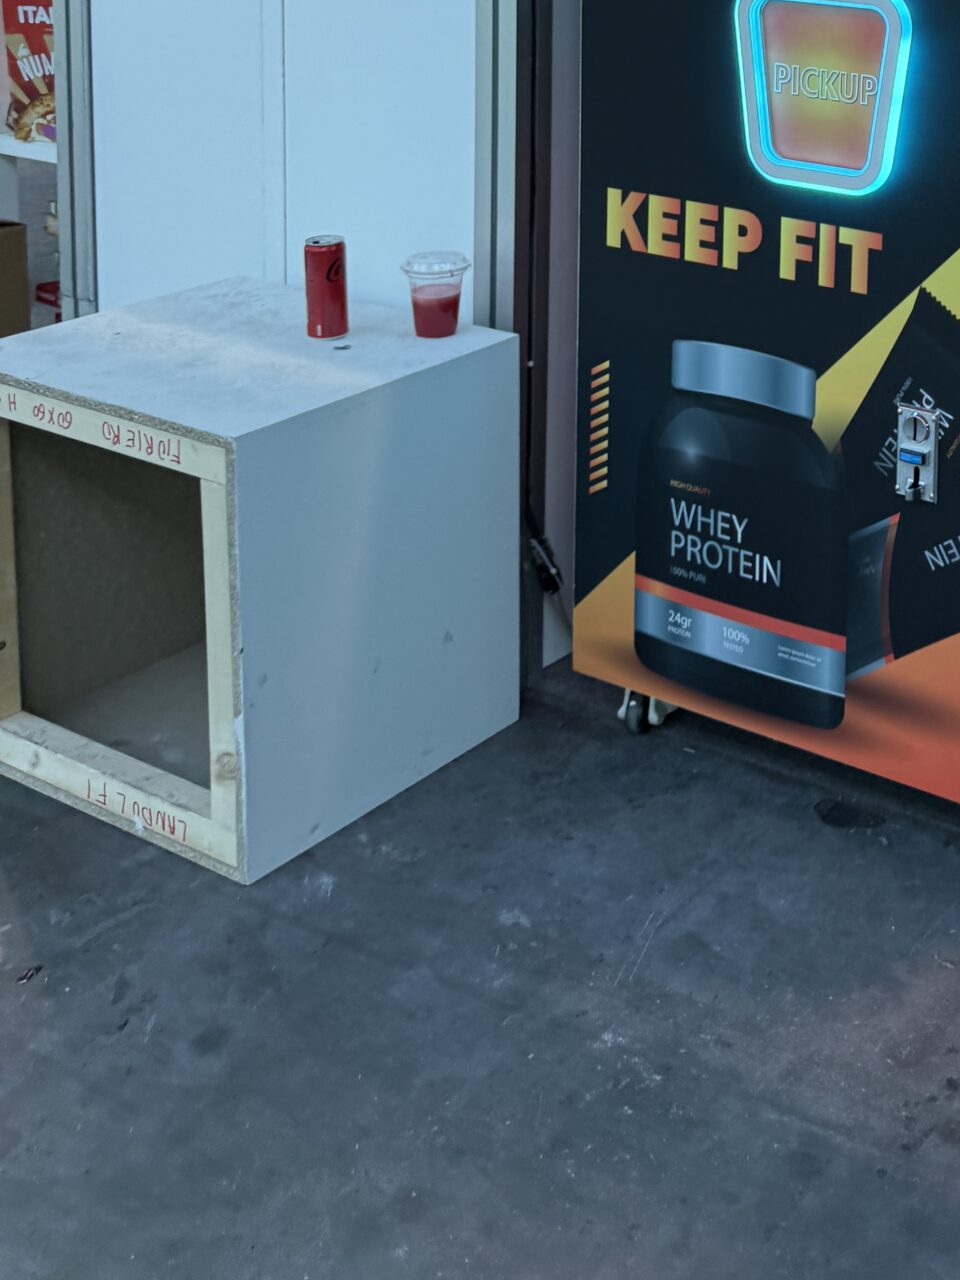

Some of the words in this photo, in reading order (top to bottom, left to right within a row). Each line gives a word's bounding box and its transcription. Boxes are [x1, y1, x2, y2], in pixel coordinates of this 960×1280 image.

[773, 62, 878, 105] PICKUP
[606, 187, 762, 270] KEEP
[779, 216, 884, 295] FIT
[670, 497, 748, 544] WHEY
[670, 530, 781, 587] PROTEIN
[668, 610, 692, 628] 24gr
[722, 626, 750, 645] 100%
